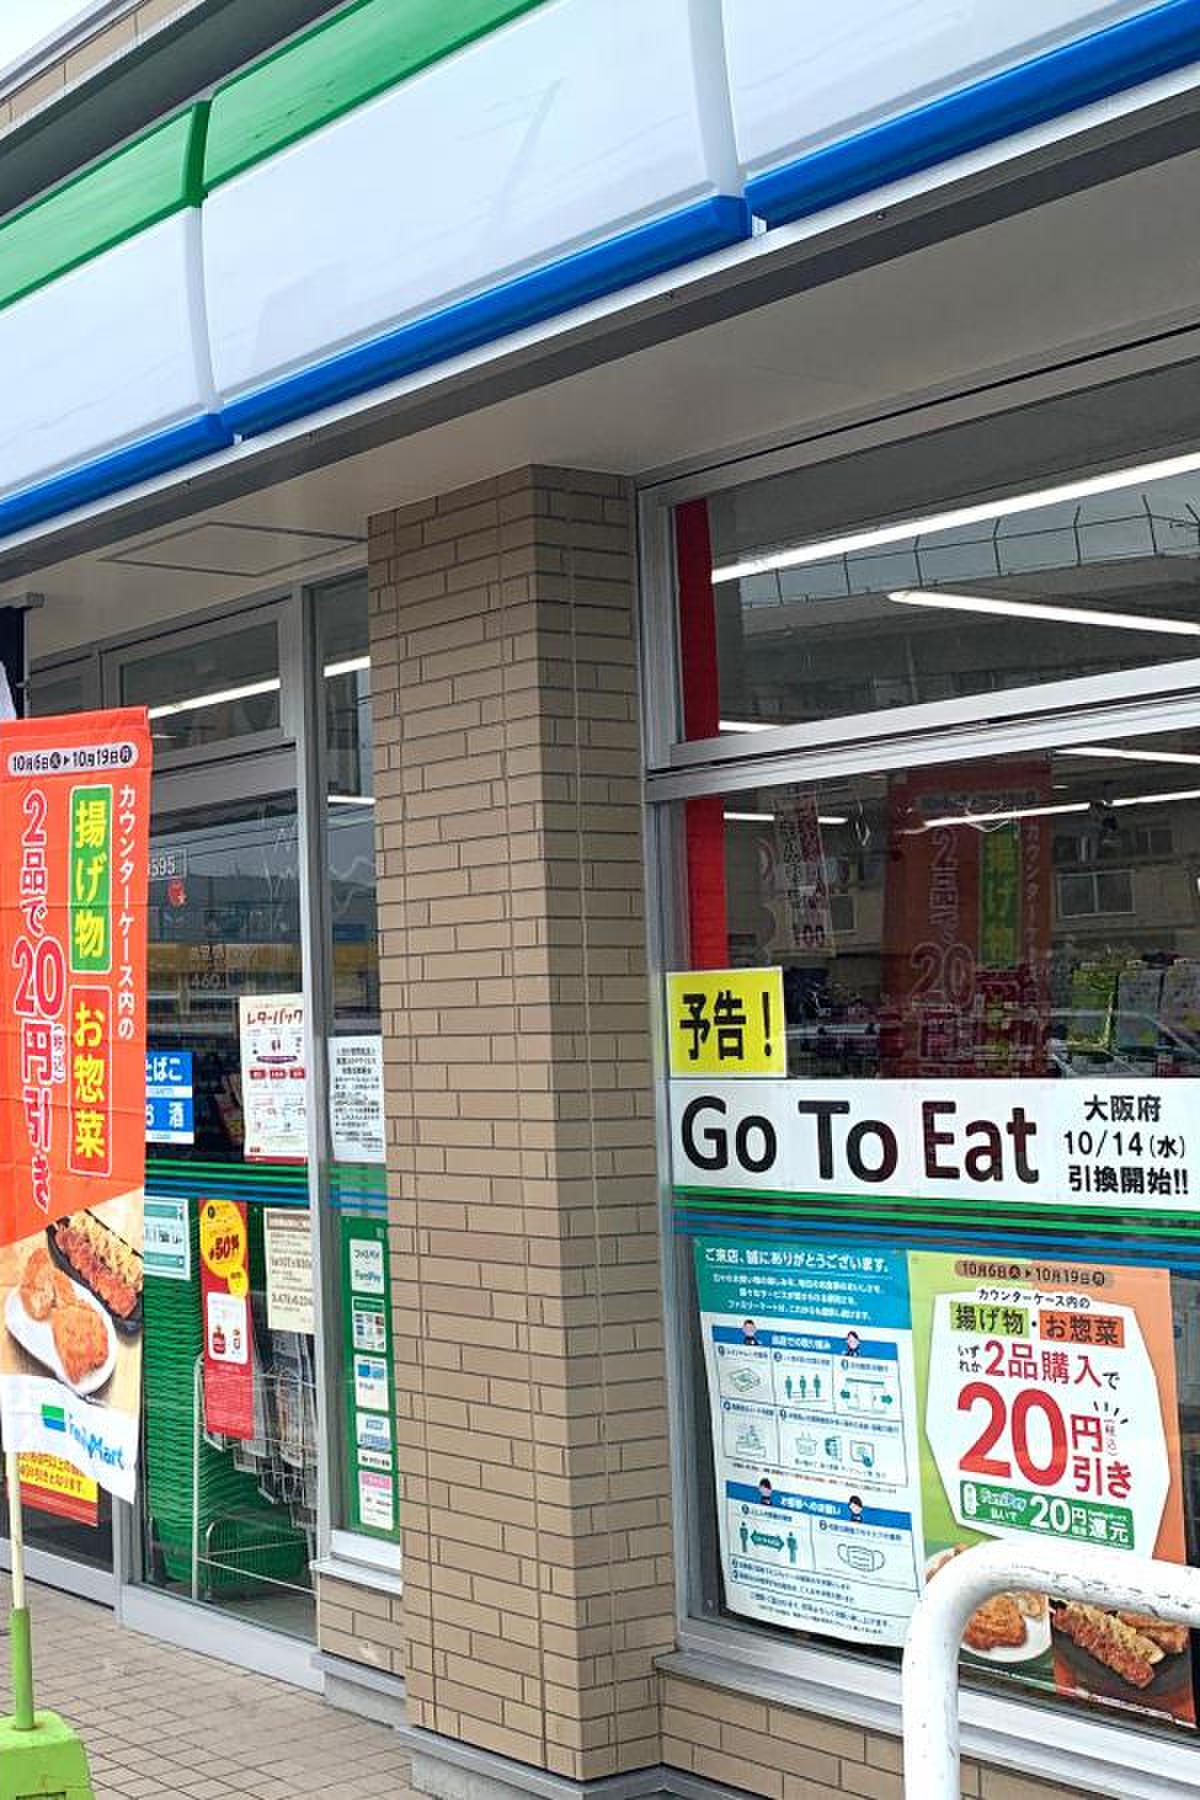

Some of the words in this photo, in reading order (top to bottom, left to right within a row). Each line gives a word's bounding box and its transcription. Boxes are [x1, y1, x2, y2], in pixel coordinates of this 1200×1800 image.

[75, 800, 108, 959] 揚げ物
[117, 785, 136, 1040] カウンターケース内の
[679, 990, 772, 1060] 予告!
[73, 1001, 106, 1159] お惣菜
[1084, 1094, 1161, 1122] 大阪府
[681, 1095, 777, 1172] Go
[798, 1100, 898, 1183] To
[921, 1100, 1040, 1184] Eat
[977, 1289, 1090, 1309] カウンターケース内の
